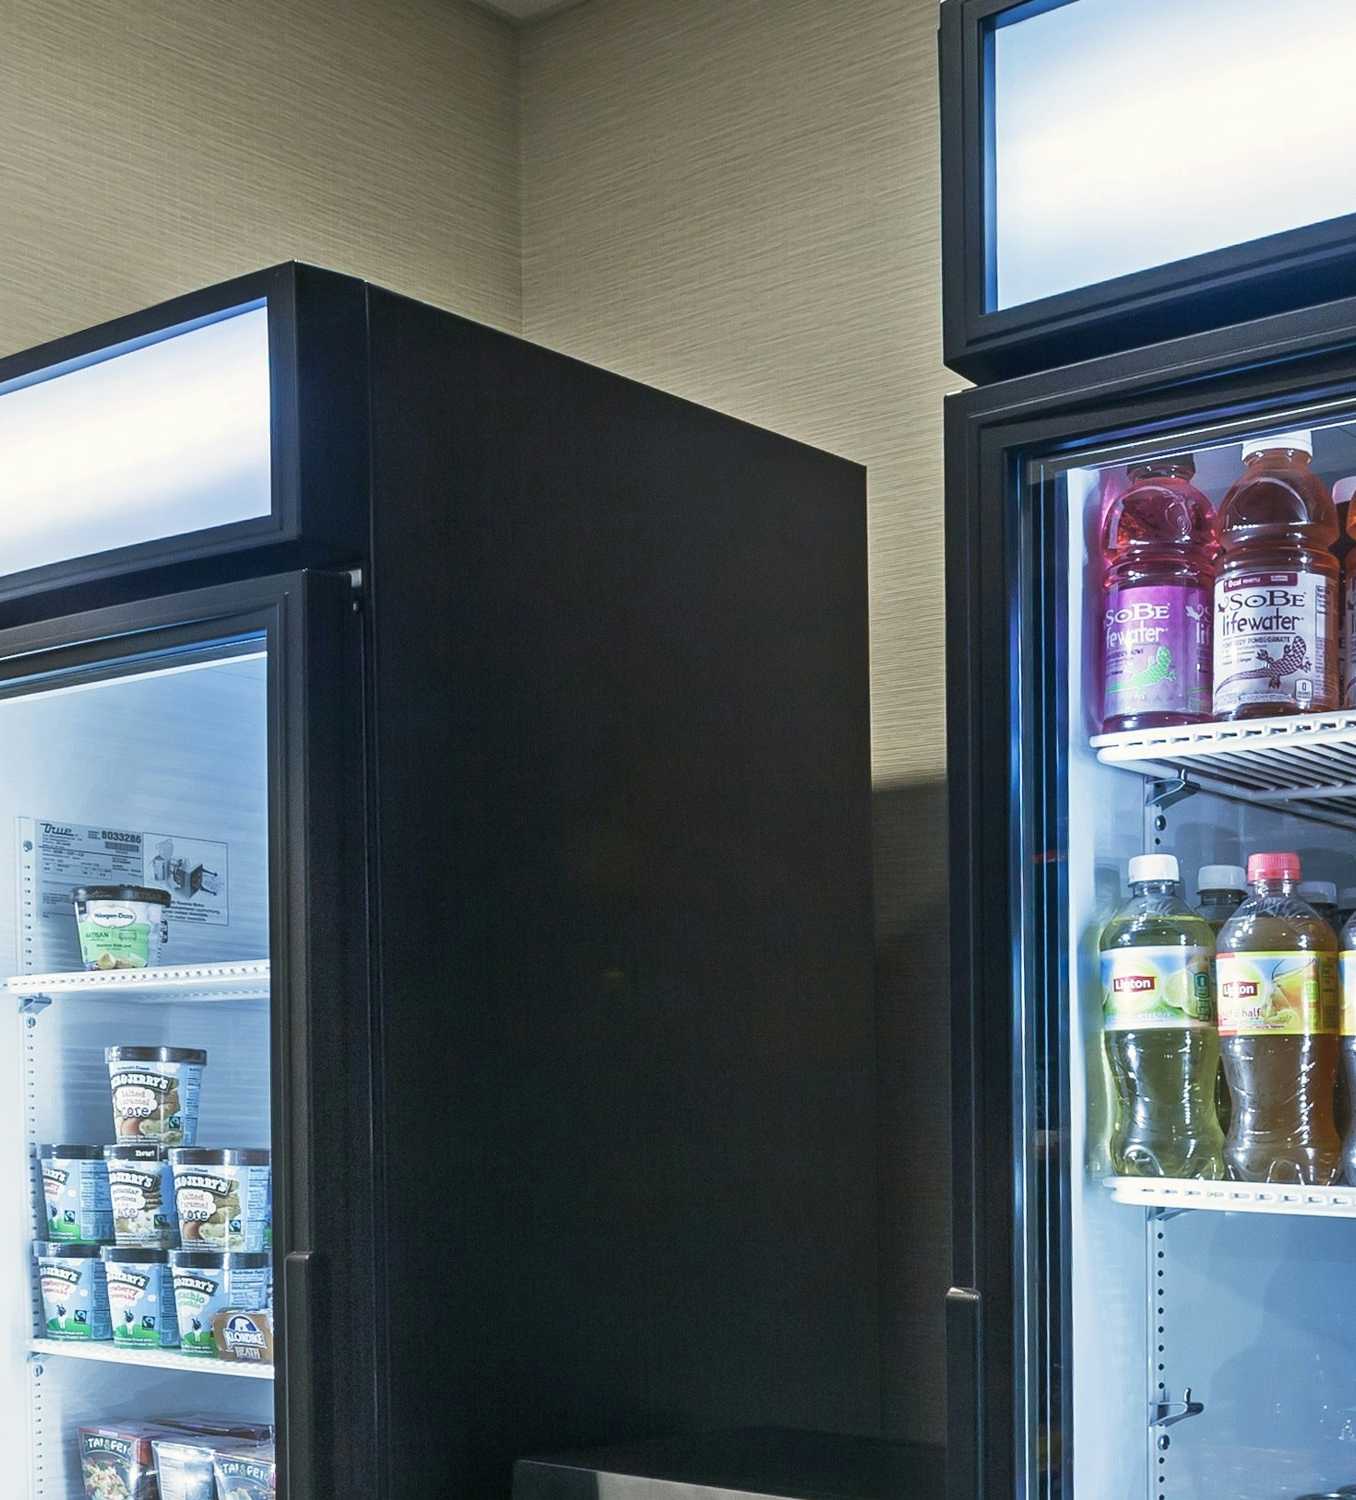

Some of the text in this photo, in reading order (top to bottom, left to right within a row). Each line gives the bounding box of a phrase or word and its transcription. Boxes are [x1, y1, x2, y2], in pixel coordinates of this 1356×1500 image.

[40, 823, 76, 837] True
[1115, 979, 1151, 990] Liton
[225, 1330, 266, 1348] KLONDIKE
[235, 1347, 262, 1361] HEATH
[87, 1438, 105, 1450] TAI
[222, 1462, 239, 1475] TAI
